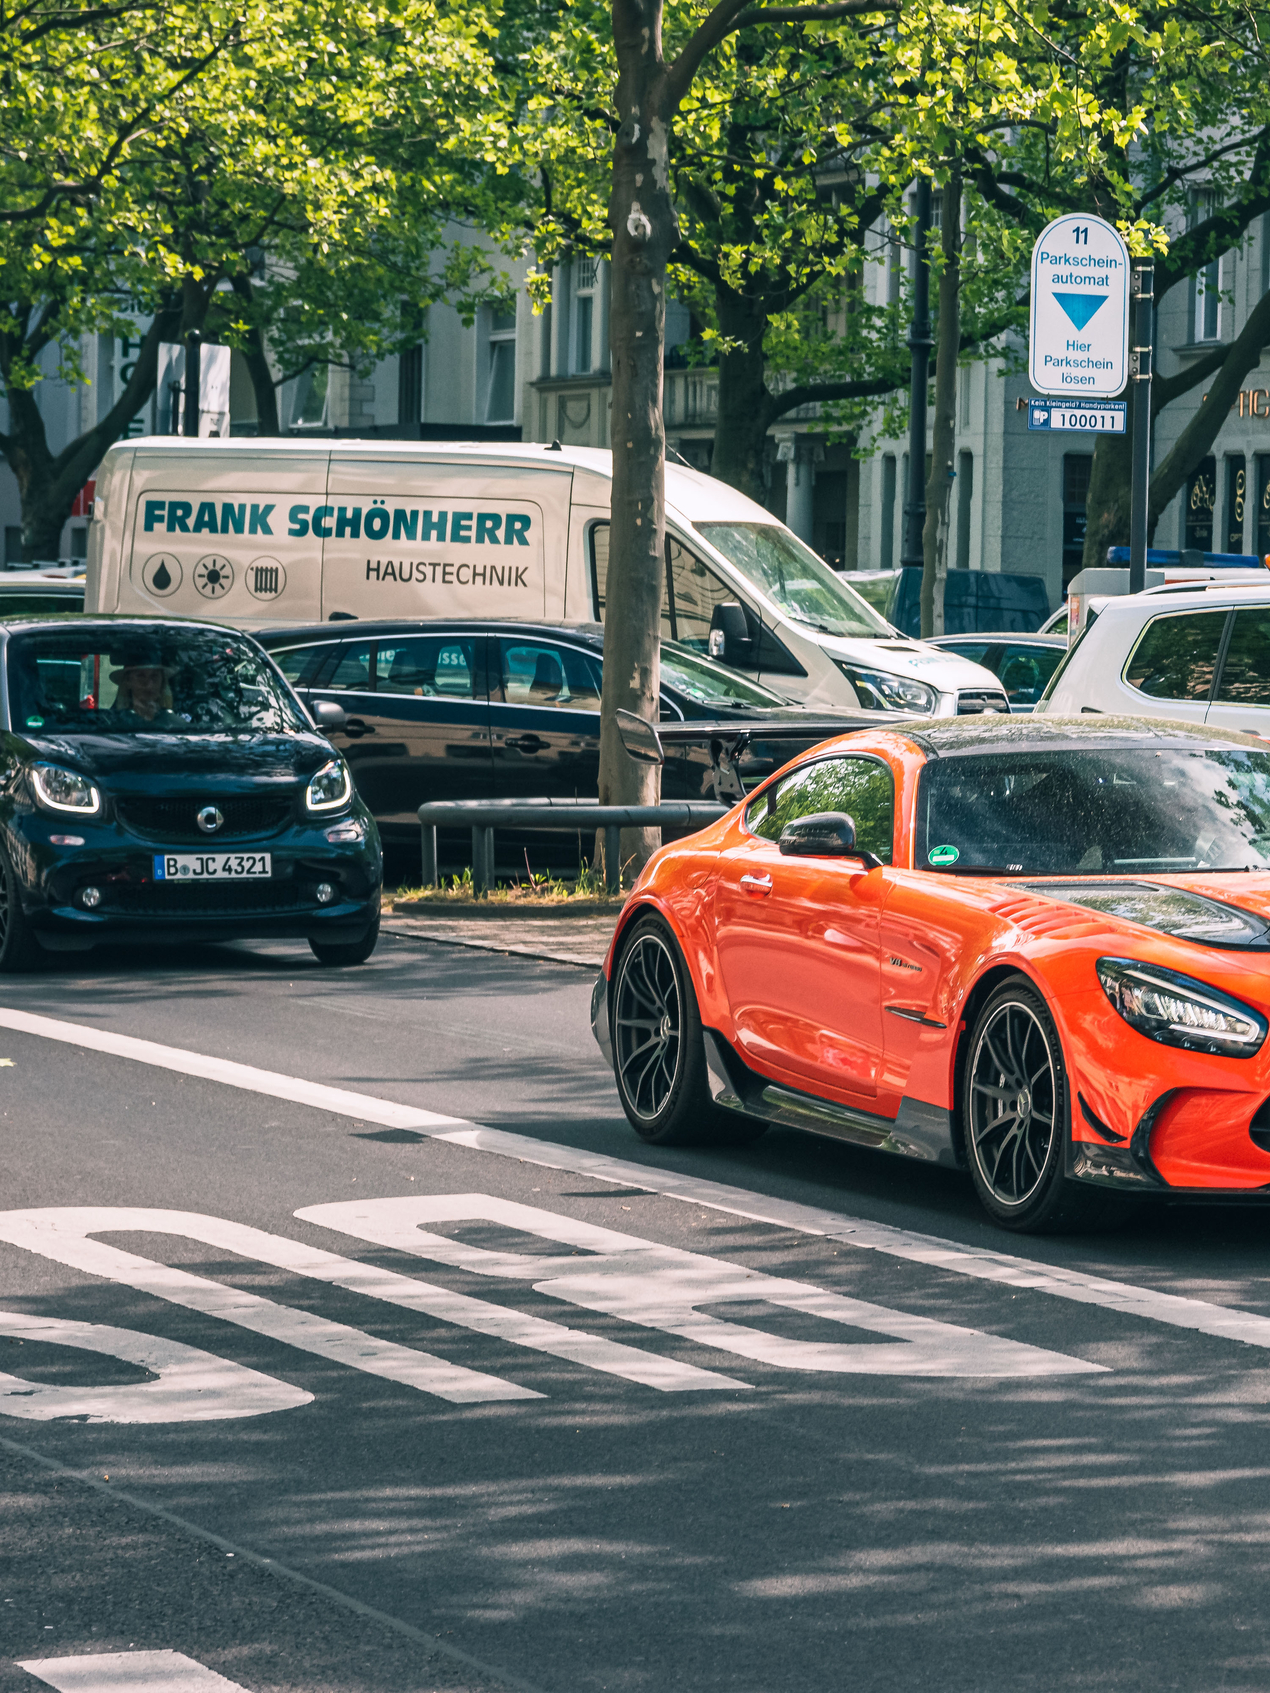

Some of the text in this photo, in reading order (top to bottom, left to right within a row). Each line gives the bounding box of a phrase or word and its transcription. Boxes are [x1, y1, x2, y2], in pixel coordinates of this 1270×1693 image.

[1072, 226, 1089, 245] 11
[1040, 252, 1123, 269] Parkschein-
[1052, 272, 1110, 287] automat
[1066, 340, 1092, 352] Hier
[1044, 355, 1114, 370] Parkschein
[1061, 372, 1096, 385] lösen
[1047, 400, 1079, 408] Kleingeld?
[1060, 413, 1115, 429] 100011
[143, 499, 532, 546] FRANK SCHÖNHERR
[366, 559, 529, 588] HAUSTECHNIK
[166, 857, 178, 876] B
[192, 857, 217, 876] JC
[222, 856, 269, 875] 4321
